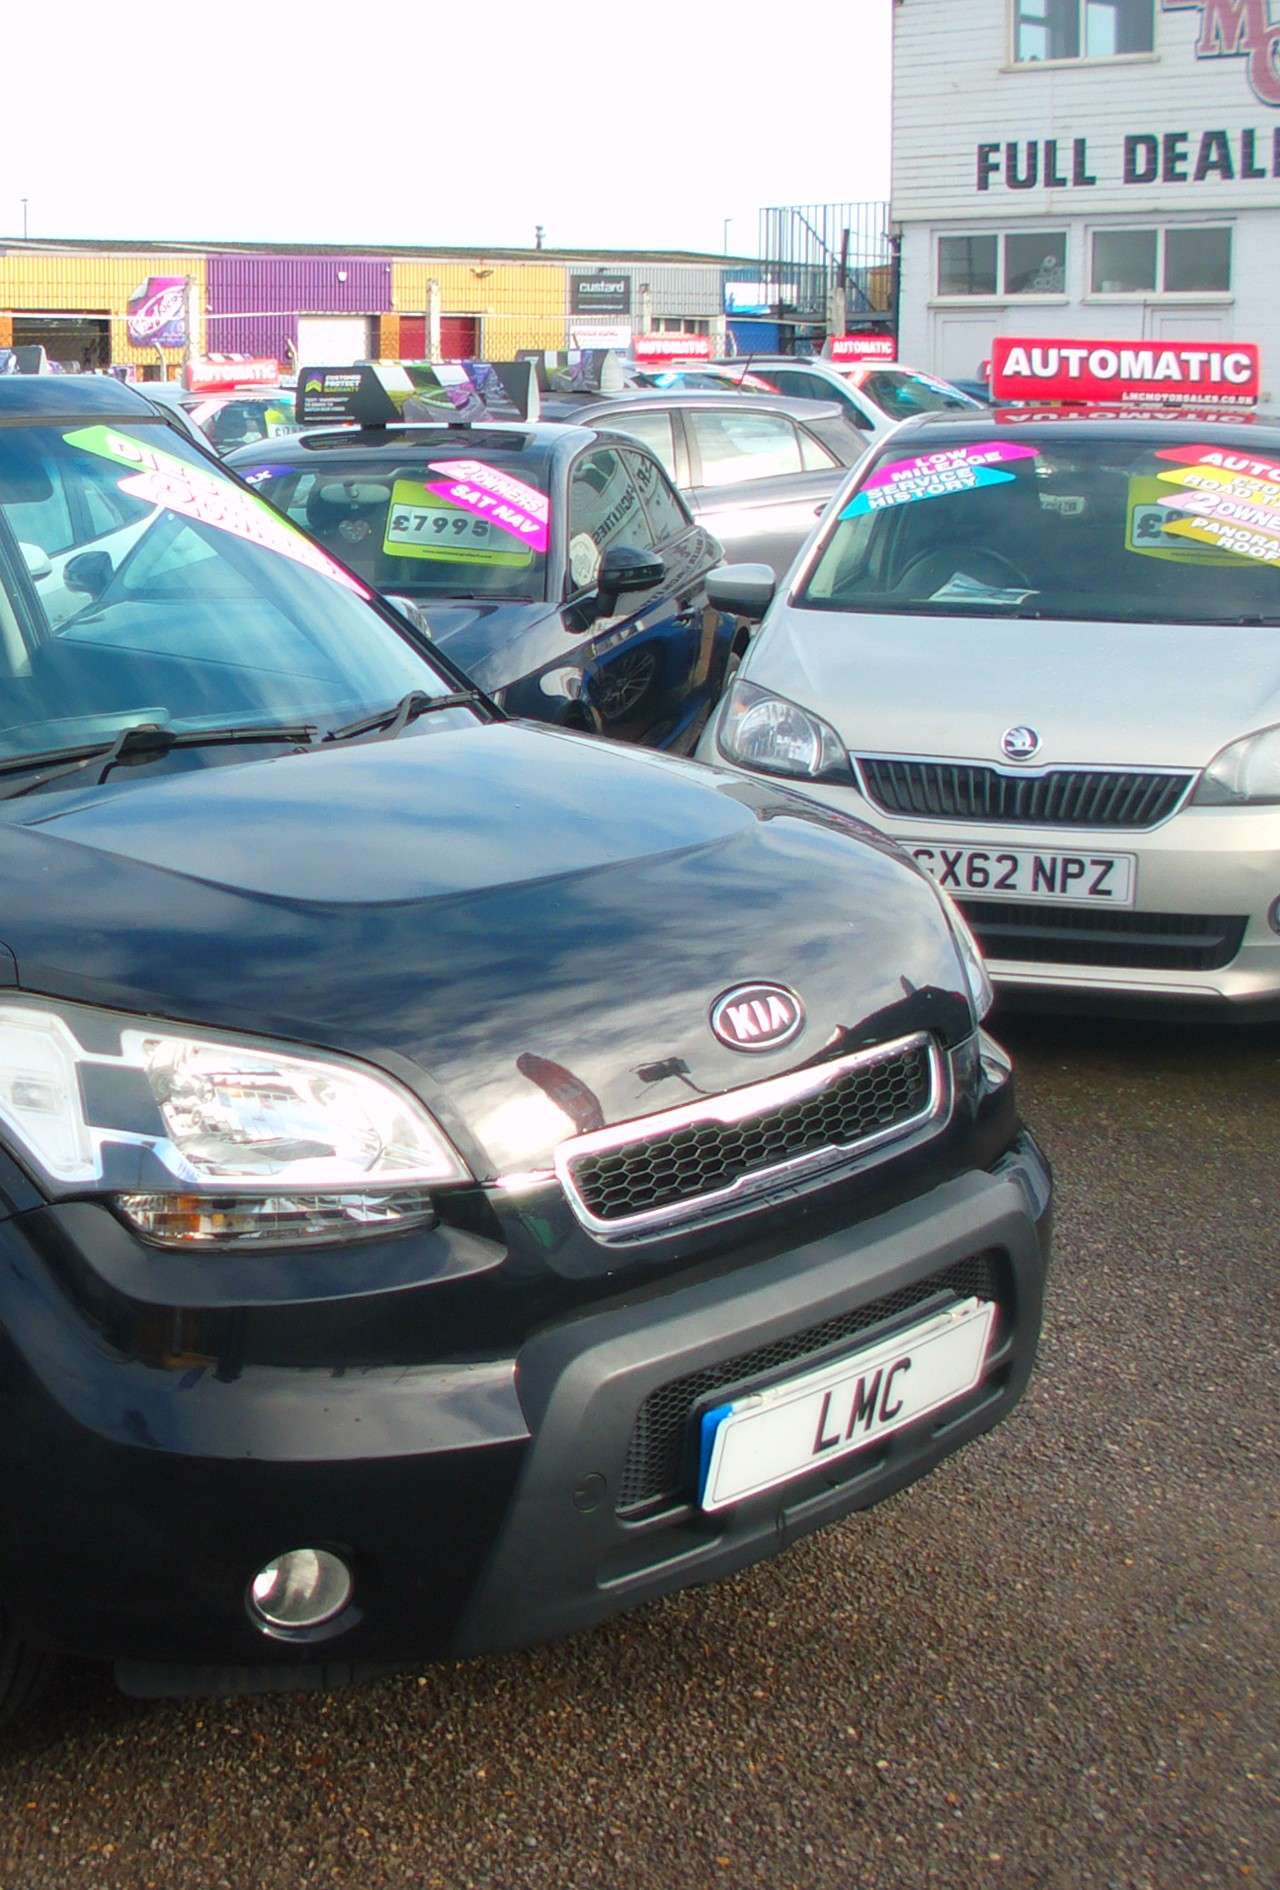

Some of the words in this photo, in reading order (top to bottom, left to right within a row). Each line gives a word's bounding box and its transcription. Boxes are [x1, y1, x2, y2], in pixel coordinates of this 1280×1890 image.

[976, 138, 1097, 191] FULL
[1123, 127, 1280, 184] DEAL
[579, 281, 625, 293] custard
[832, 340, 893, 354] AUTOMATIC
[1002, 347, 1252, 384] AUTOMATIC
[891, 451, 1003, 482] MILEAGE
[914, 448, 969, 467] LOW
[476, 468, 545, 513] OWNERS
[866, 468, 976, 498] SERVICE
[869, 477, 978, 509] HISTORY
[1184, 475, 1252, 499] ROAD
[450, 485, 497, 508] SAT
[491, 505, 540, 533] NAV
[392, 514, 489, 537] £7995
[1216, 536, 1280, 561] ROOF
[1031, 856, 1114, 896] NPZ
[726, 996, 790, 1040] KIA
[812, 1356, 912, 1455] LMC
